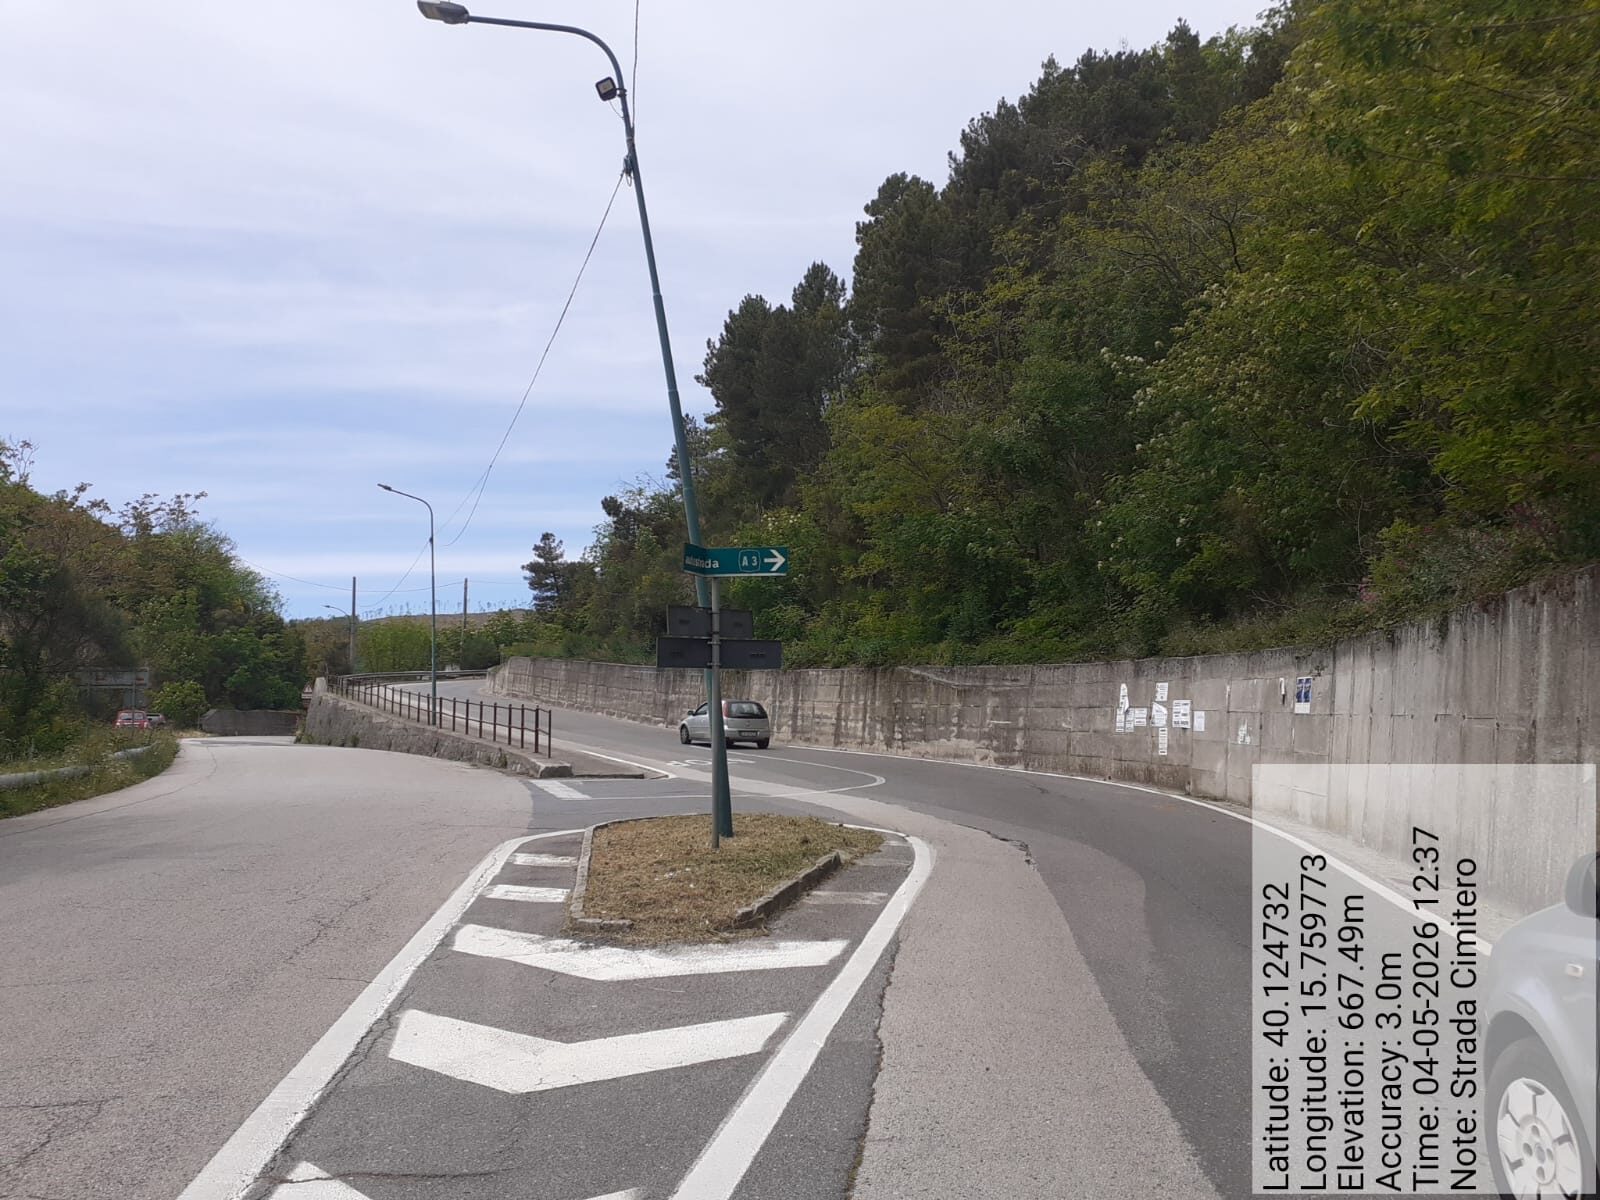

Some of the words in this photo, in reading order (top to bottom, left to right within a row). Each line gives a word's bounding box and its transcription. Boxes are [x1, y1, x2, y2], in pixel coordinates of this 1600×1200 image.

[742, 556, 749, 567] A
[751, 556, 758, 567] 3
[666, 758, 755, 767] SOP
